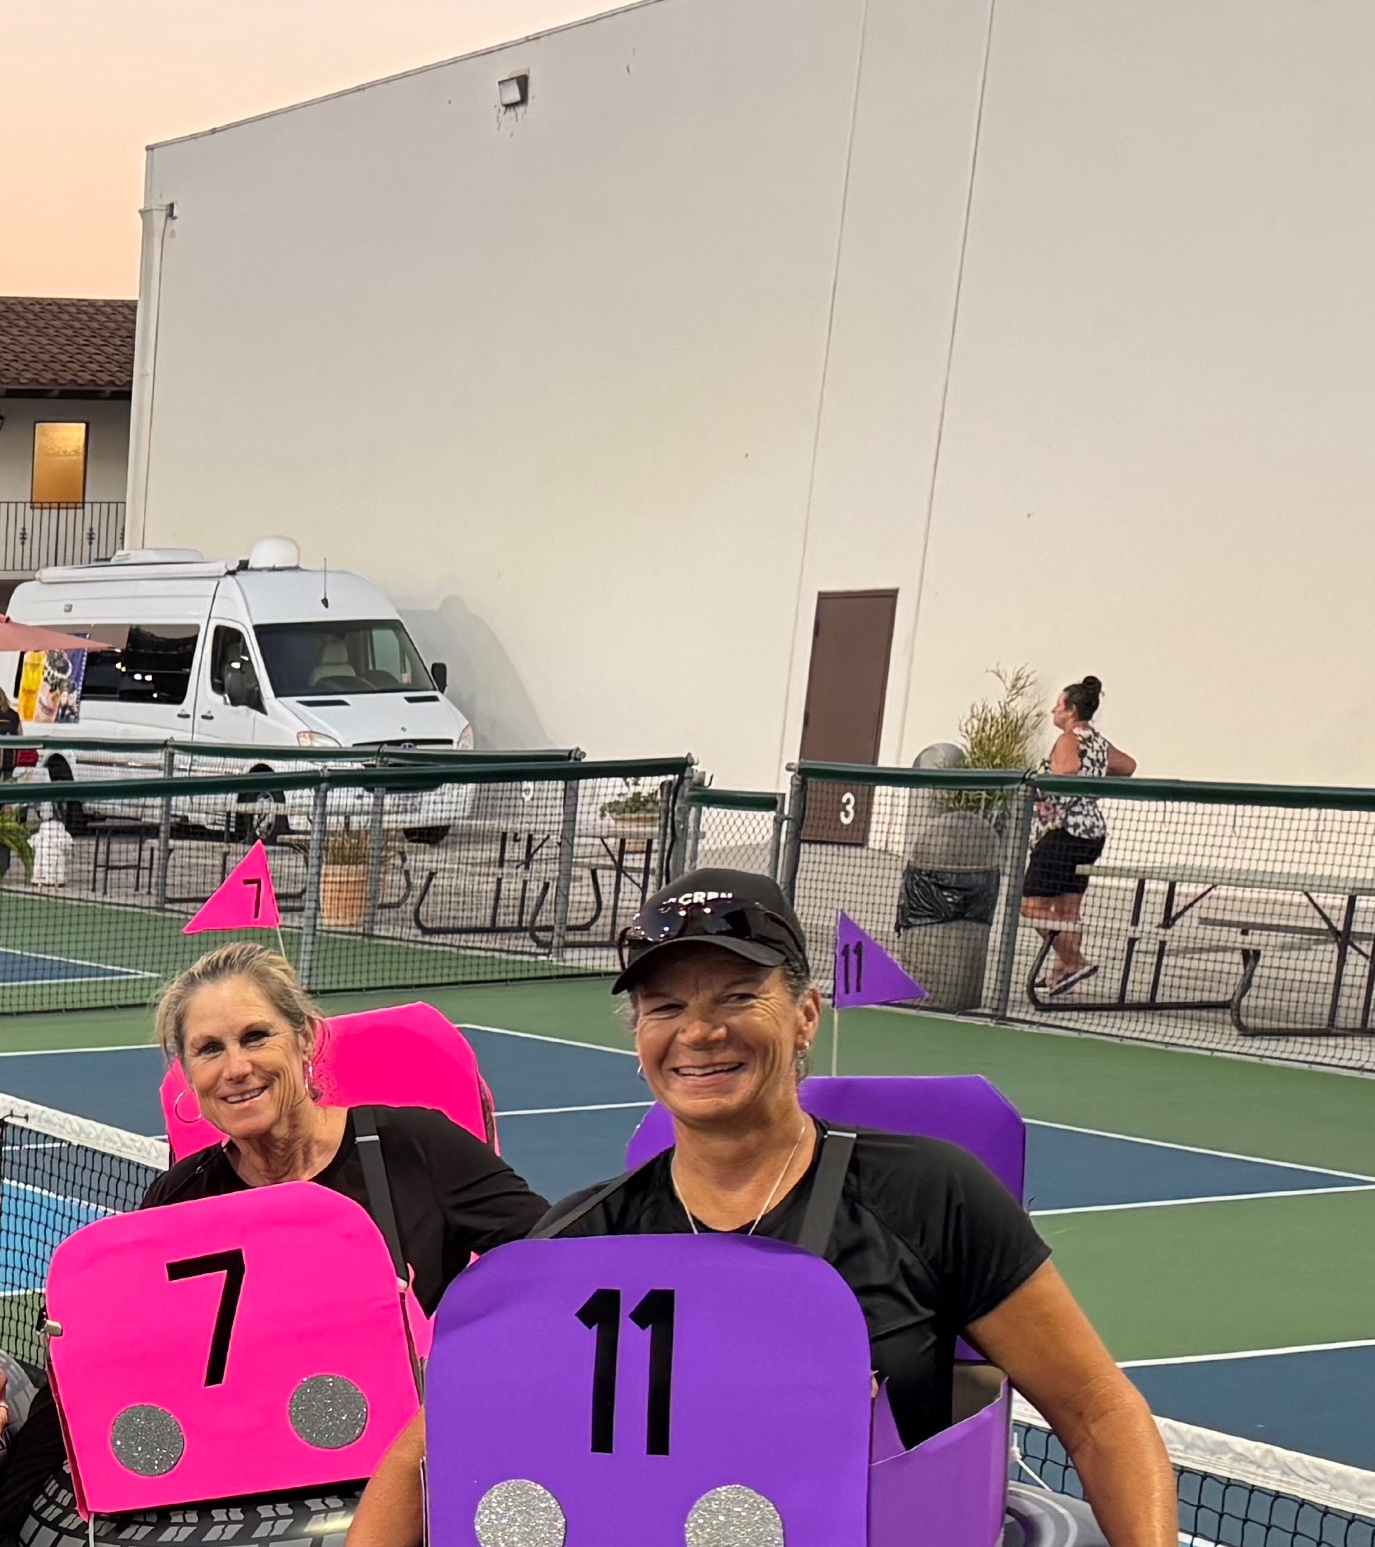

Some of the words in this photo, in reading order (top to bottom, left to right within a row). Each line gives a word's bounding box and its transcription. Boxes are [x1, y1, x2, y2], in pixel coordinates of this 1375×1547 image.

[840, 792, 855, 825] 3
[242, 879, 262, 919] 7
[841, 941, 863, 994] 11
[166, 1249, 246, 1387] 7
[575, 1288, 676, 1456] 11
